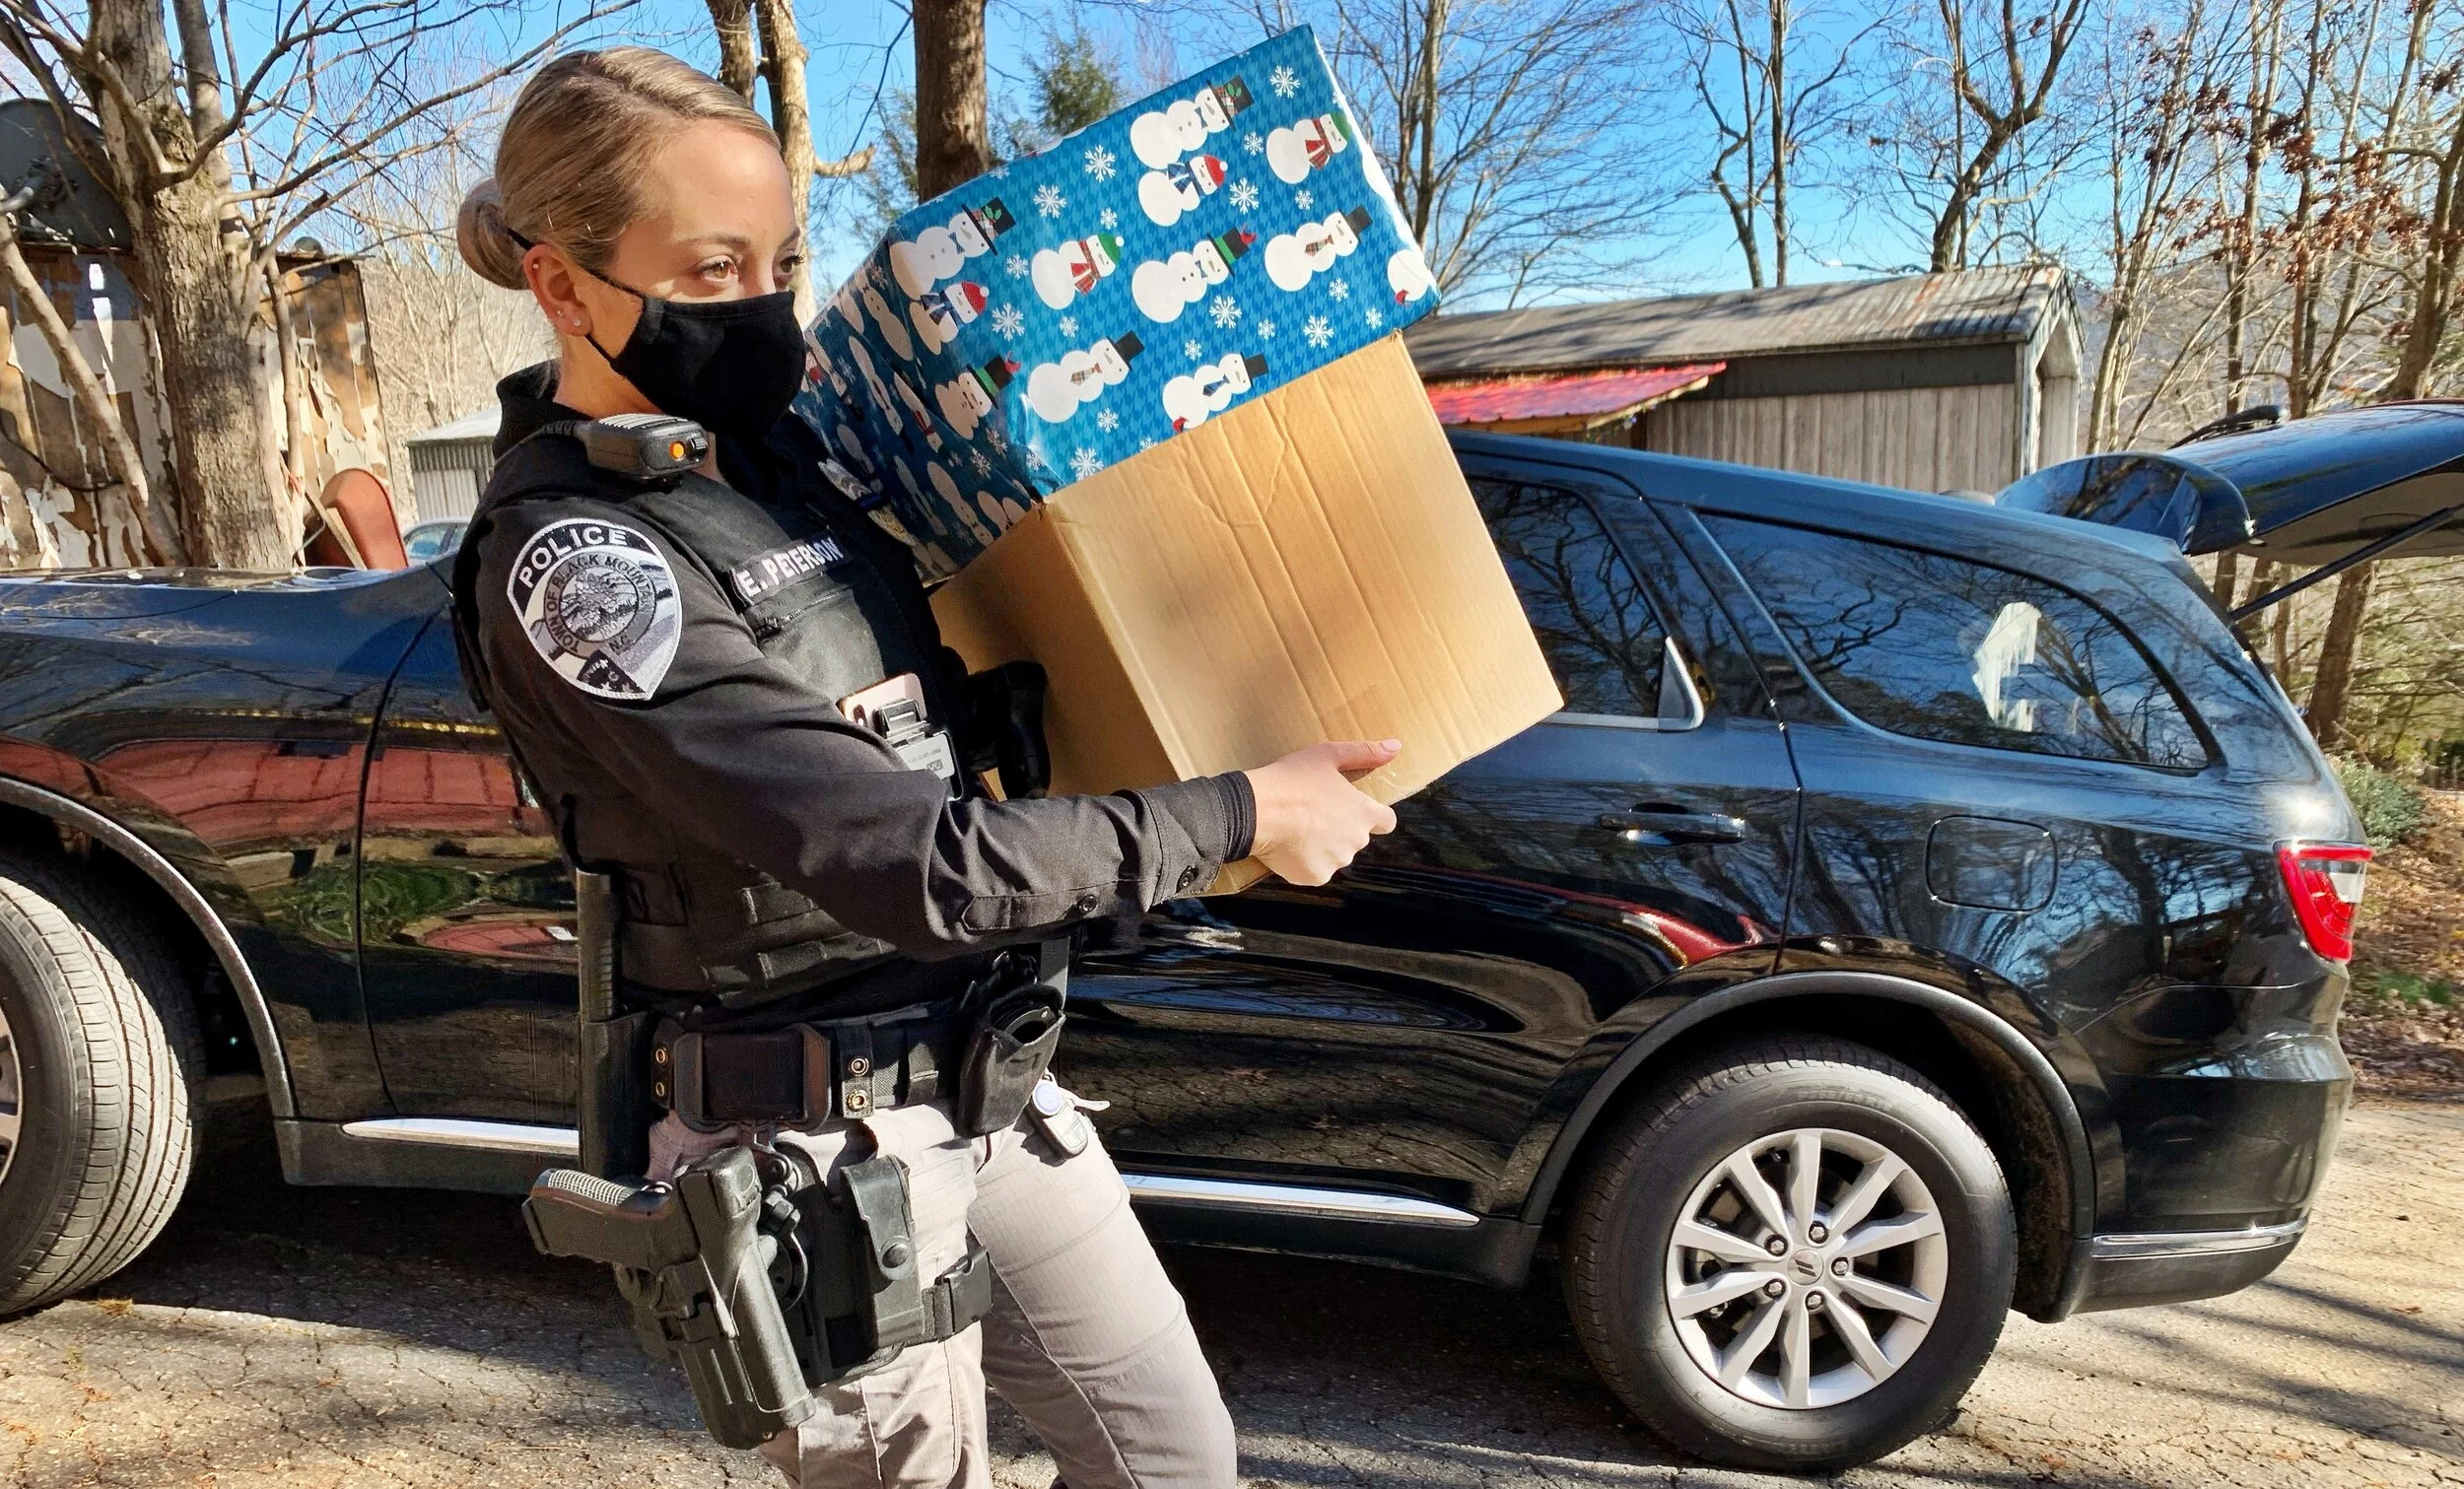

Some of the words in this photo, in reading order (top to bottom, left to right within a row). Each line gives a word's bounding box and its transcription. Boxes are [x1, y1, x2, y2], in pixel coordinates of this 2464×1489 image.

[518, 526, 628, 588] POLICE
[552, 554, 599, 587] BLACK
[735, 570, 769, 597] E.
[761, 536, 845, 586] PETERSON
[546, 591, 559, 612] OF
[548, 614, 581, 653] TOWN
